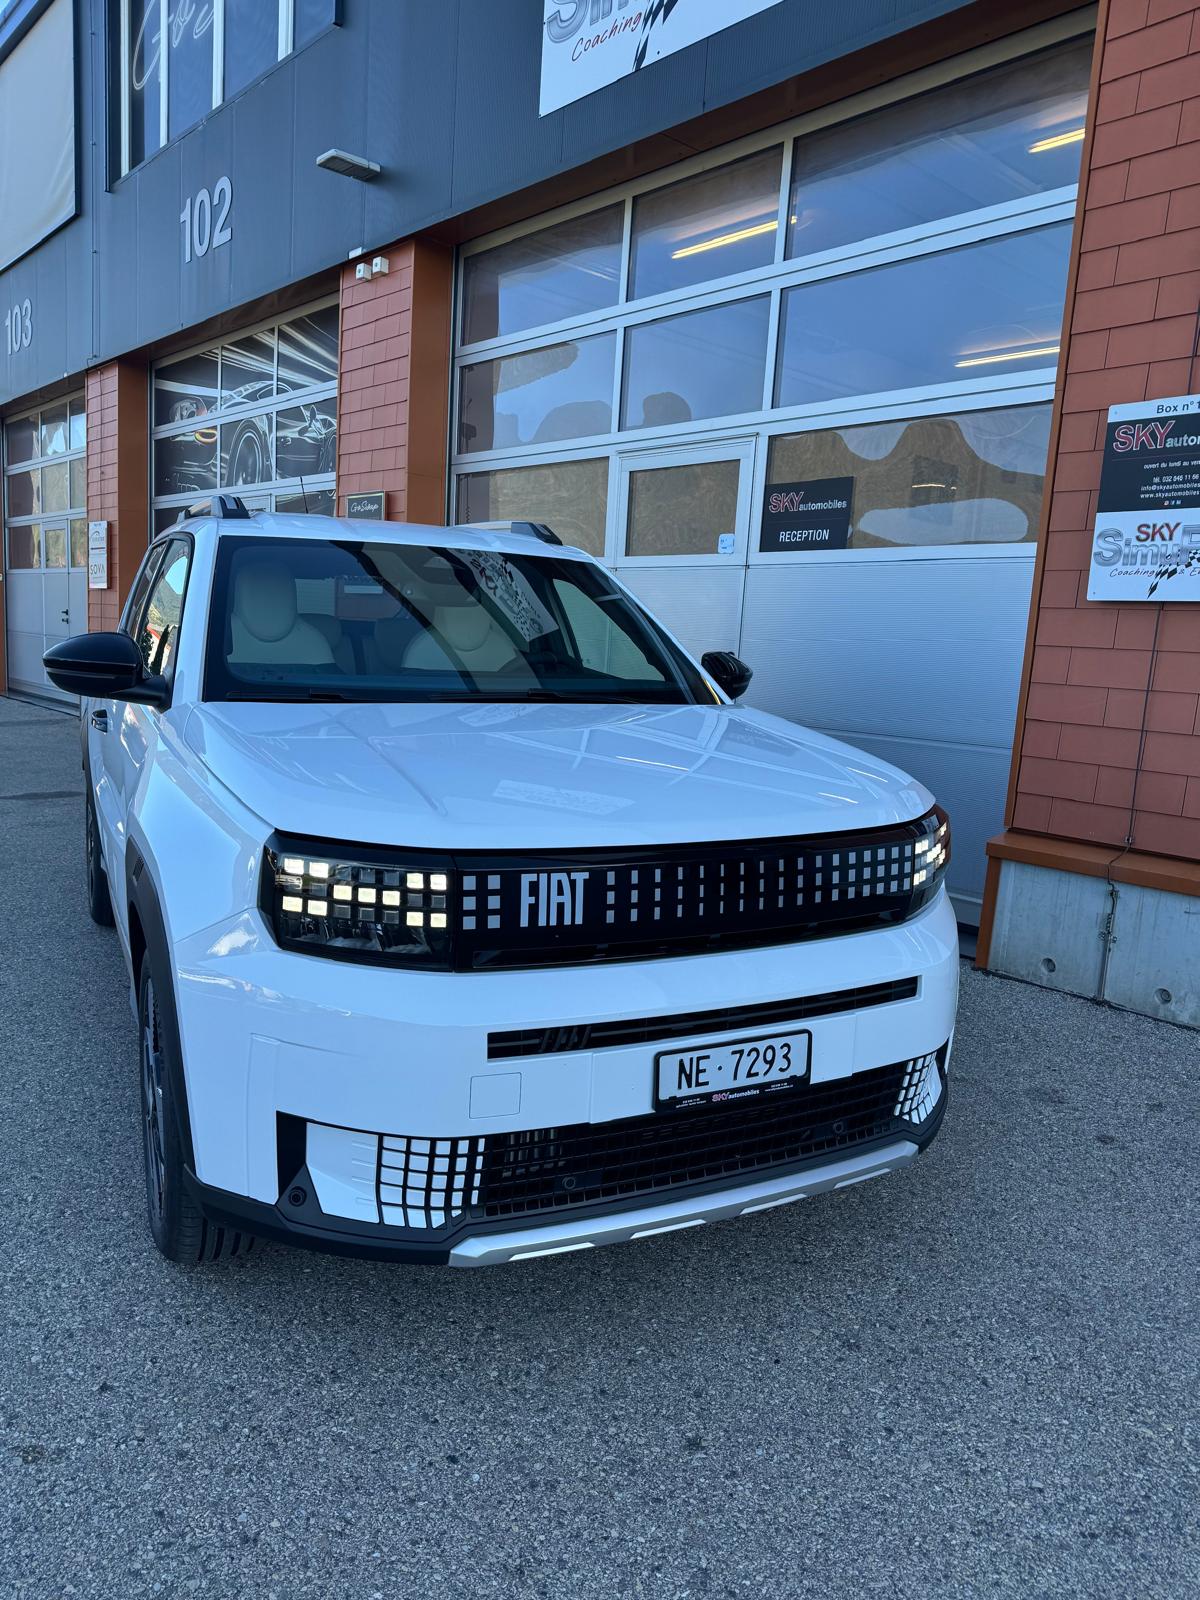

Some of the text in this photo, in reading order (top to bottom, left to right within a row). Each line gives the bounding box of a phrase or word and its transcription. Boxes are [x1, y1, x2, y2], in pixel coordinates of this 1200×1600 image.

[571, 11, 643, 62] Coaching
[180, 175, 232, 264] 102
[4, 298, 33, 355] 103
[1156, 404, 1178, 414] Box
[1112, 420, 1200, 452] SKYauto
[778, 529, 830, 542] RECEPTION
[1135, 522, 1181, 542] SKY
[520, 872, 590, 928] FIAT
[730, 1043, 792, 1081] 7293
